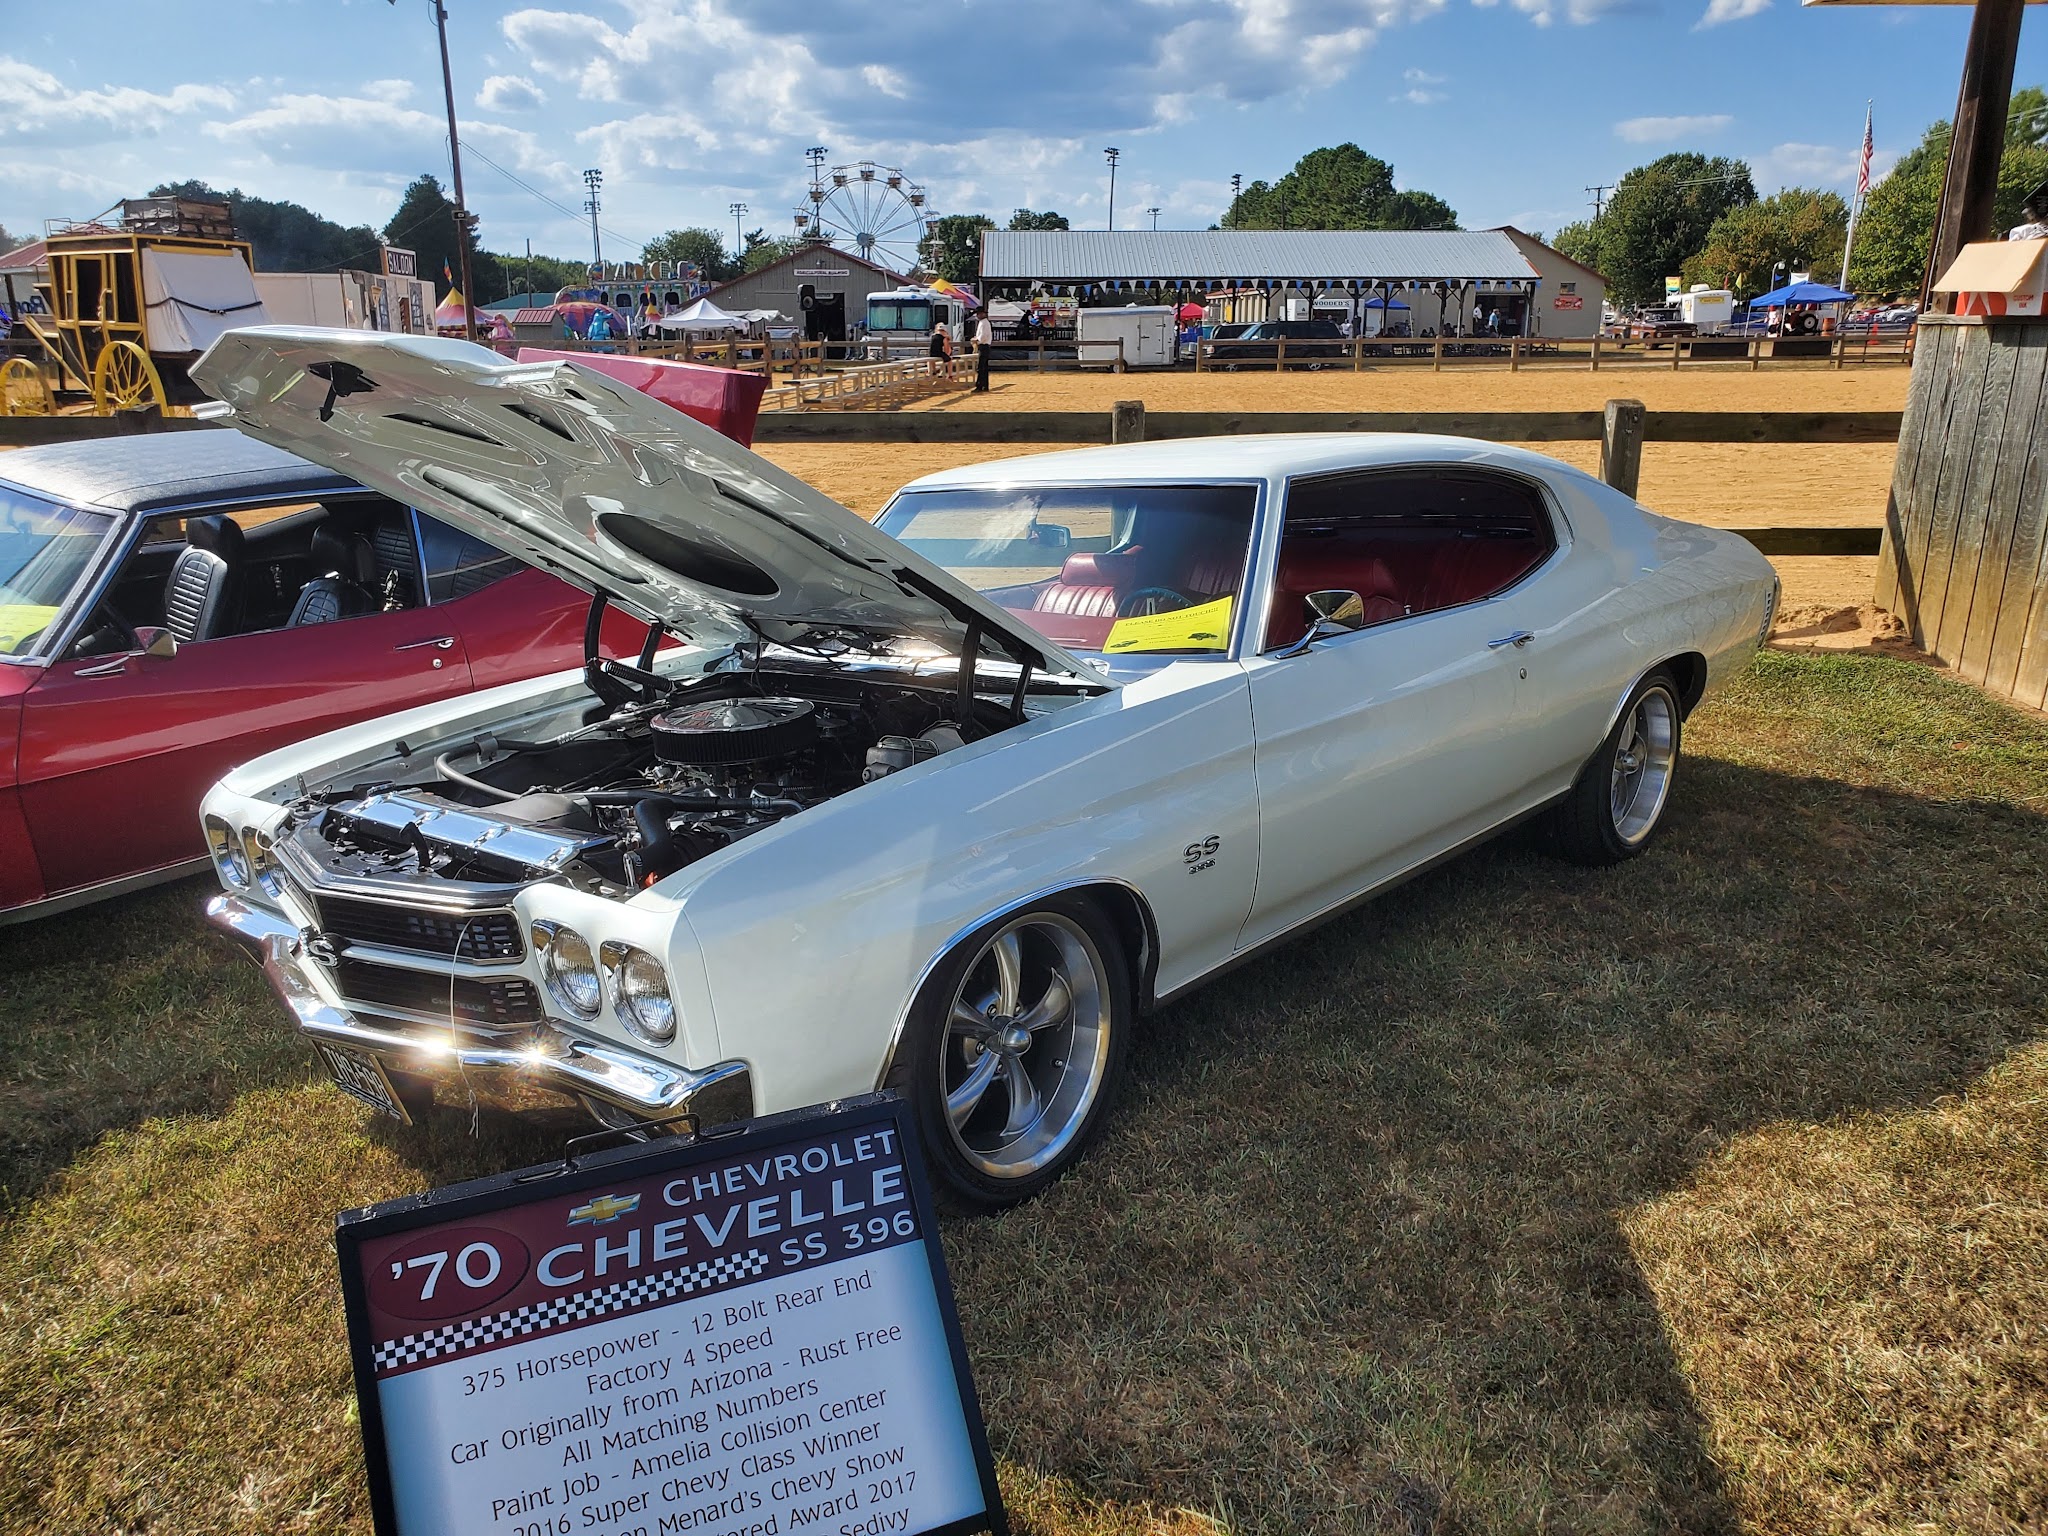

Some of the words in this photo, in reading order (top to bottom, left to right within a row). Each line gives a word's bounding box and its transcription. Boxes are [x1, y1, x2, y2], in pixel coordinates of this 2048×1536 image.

[388, 252, 414, 275] SALOON
[1183, 836, 1220, 864] SS
[664, 1129, 896, 1207] CHEVROLET
[537, 1165, 904, 1288] CHEVELLE
[780, 1232, 828, 1266] SS
[842, 1210, 915, 1250] 396
[391, 1242, 501, 1301] '70
[462, 1368, 505, 1397] 375
[517, 1328, 660, 1382] Horsepower
[691, 1312, 716, 1336] 12
[723, 1299, 769, 1327] Bolt
[776, 1286, 825, 1313] Rear
[833, 1269, 872, 1297] End
[587, 1356, 672, 1395] Factory
[683, 1348, 697, 1368] 4
[704, 1325, 774, 1364] Speed
[450, 1438, 489, 1465] Car
[501, 1404, 612, 1450] Originally
[622, 1387, 680, 1417] from
[690, 1361, 773, 1399] Arizona
[798, 1338, 849, 1368] Rust
[855, 1325, 902, 1352] Free
[562, 1438, 592, 1468] All
[601, 1410, 709, 1456] Matching
[715, 1379, 819, 1423] Numbers
[491, 1486, 555, 1522] Paint
[562, 1471, 600, 1506] Job
[631, 1441, 712, 1481] Amelia
[720, 1413, 811, 1452] Collision
[819, 1389, 887, 1423] Center
[581, 1491, 650, 1528] Super
[661, 1467, 730, 1502] Chevy
[741, 1448, 796, 1478] Class
[801, 1421, 881, 1459] Winner
[657, 1490, 762, 1536] Menard's
[771, 1466, 837, 1501] Chevy
[845, 1445, 905, 1479] Show
[789, 1488, 859, 1530] Award
[867, 1470, 916, 1504] 2017
